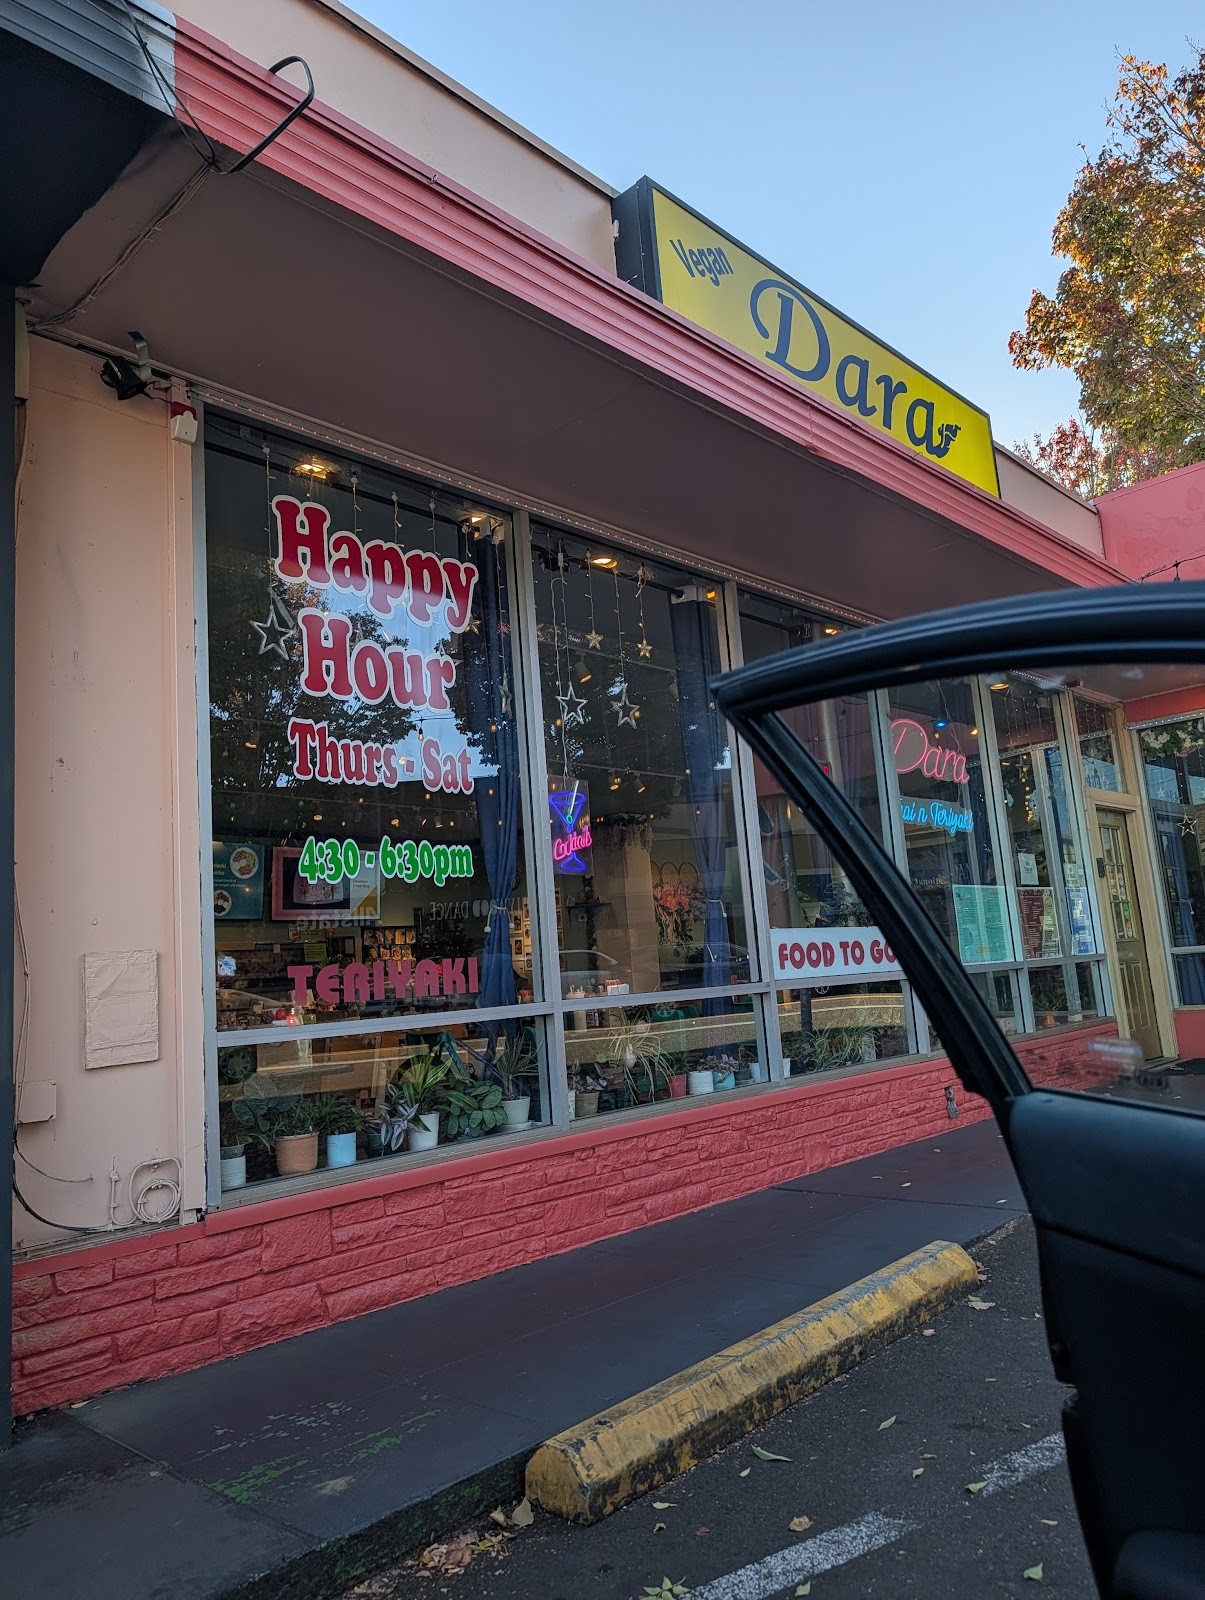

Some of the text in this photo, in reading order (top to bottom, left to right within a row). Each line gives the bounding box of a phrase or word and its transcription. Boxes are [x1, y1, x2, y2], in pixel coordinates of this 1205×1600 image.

[669, 239, 734, 287] Vegan
[750, 278, 961, 458] Dara
[272, 495, 478, 633] Happy
[298, 608, 456, 714] Hour
[288, 717, 398, 788] Thurs
[421, 737, 475, 795] Sat
[891, 718, 970, 783] Dara
[918, 807, 928, 823] n
[930, 802, 974, 834] Teriyaki
[299, 835, 360, 886] 4:30
[379, 834, 474, 887] 6:30pm
[287, 957, 479, 1006] TERIYAKI
[778, 939, 896, 970] FOOD TO GO
